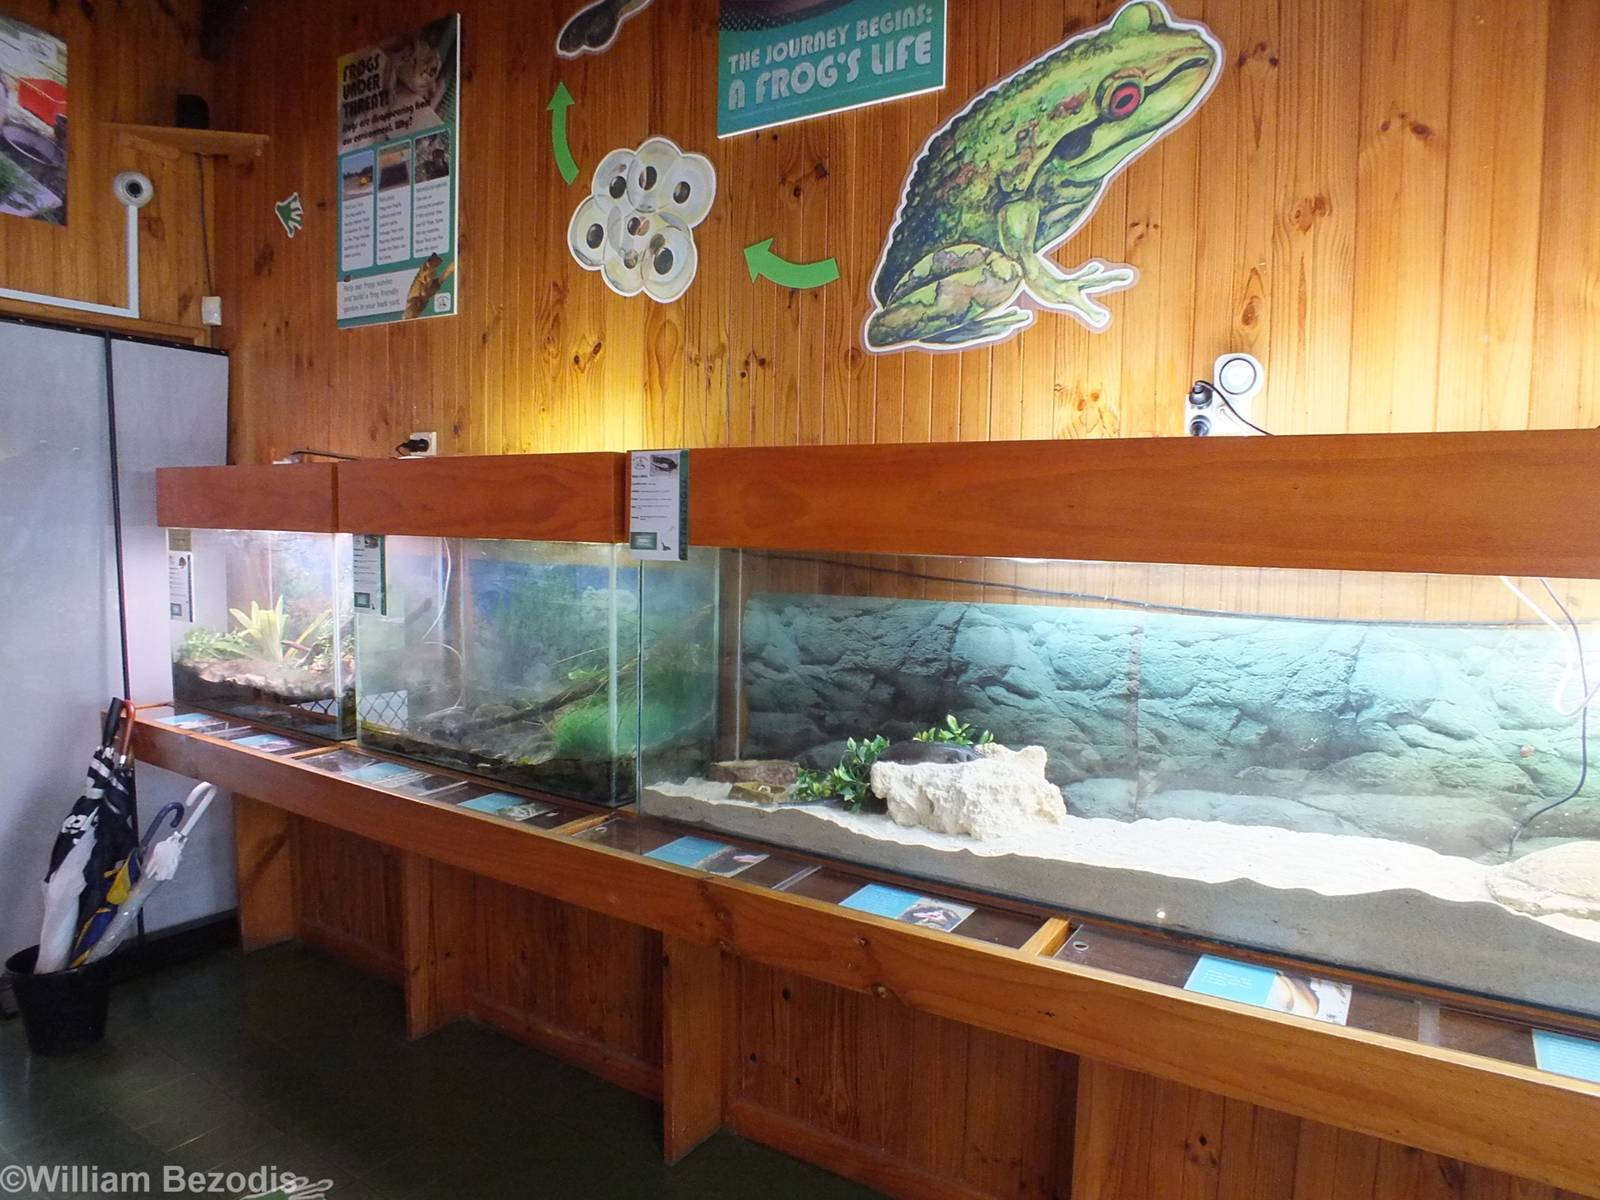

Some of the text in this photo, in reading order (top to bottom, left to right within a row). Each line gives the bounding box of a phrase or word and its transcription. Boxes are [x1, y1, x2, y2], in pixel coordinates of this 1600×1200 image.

[727, 3, 933, 75] THE JOURNEY BEGINS:
[342, 72, 380, 100] UNDER
[343, 52, 381, 83] FROGS
[727, 30, 933, 111] A FROG'S LIFE
